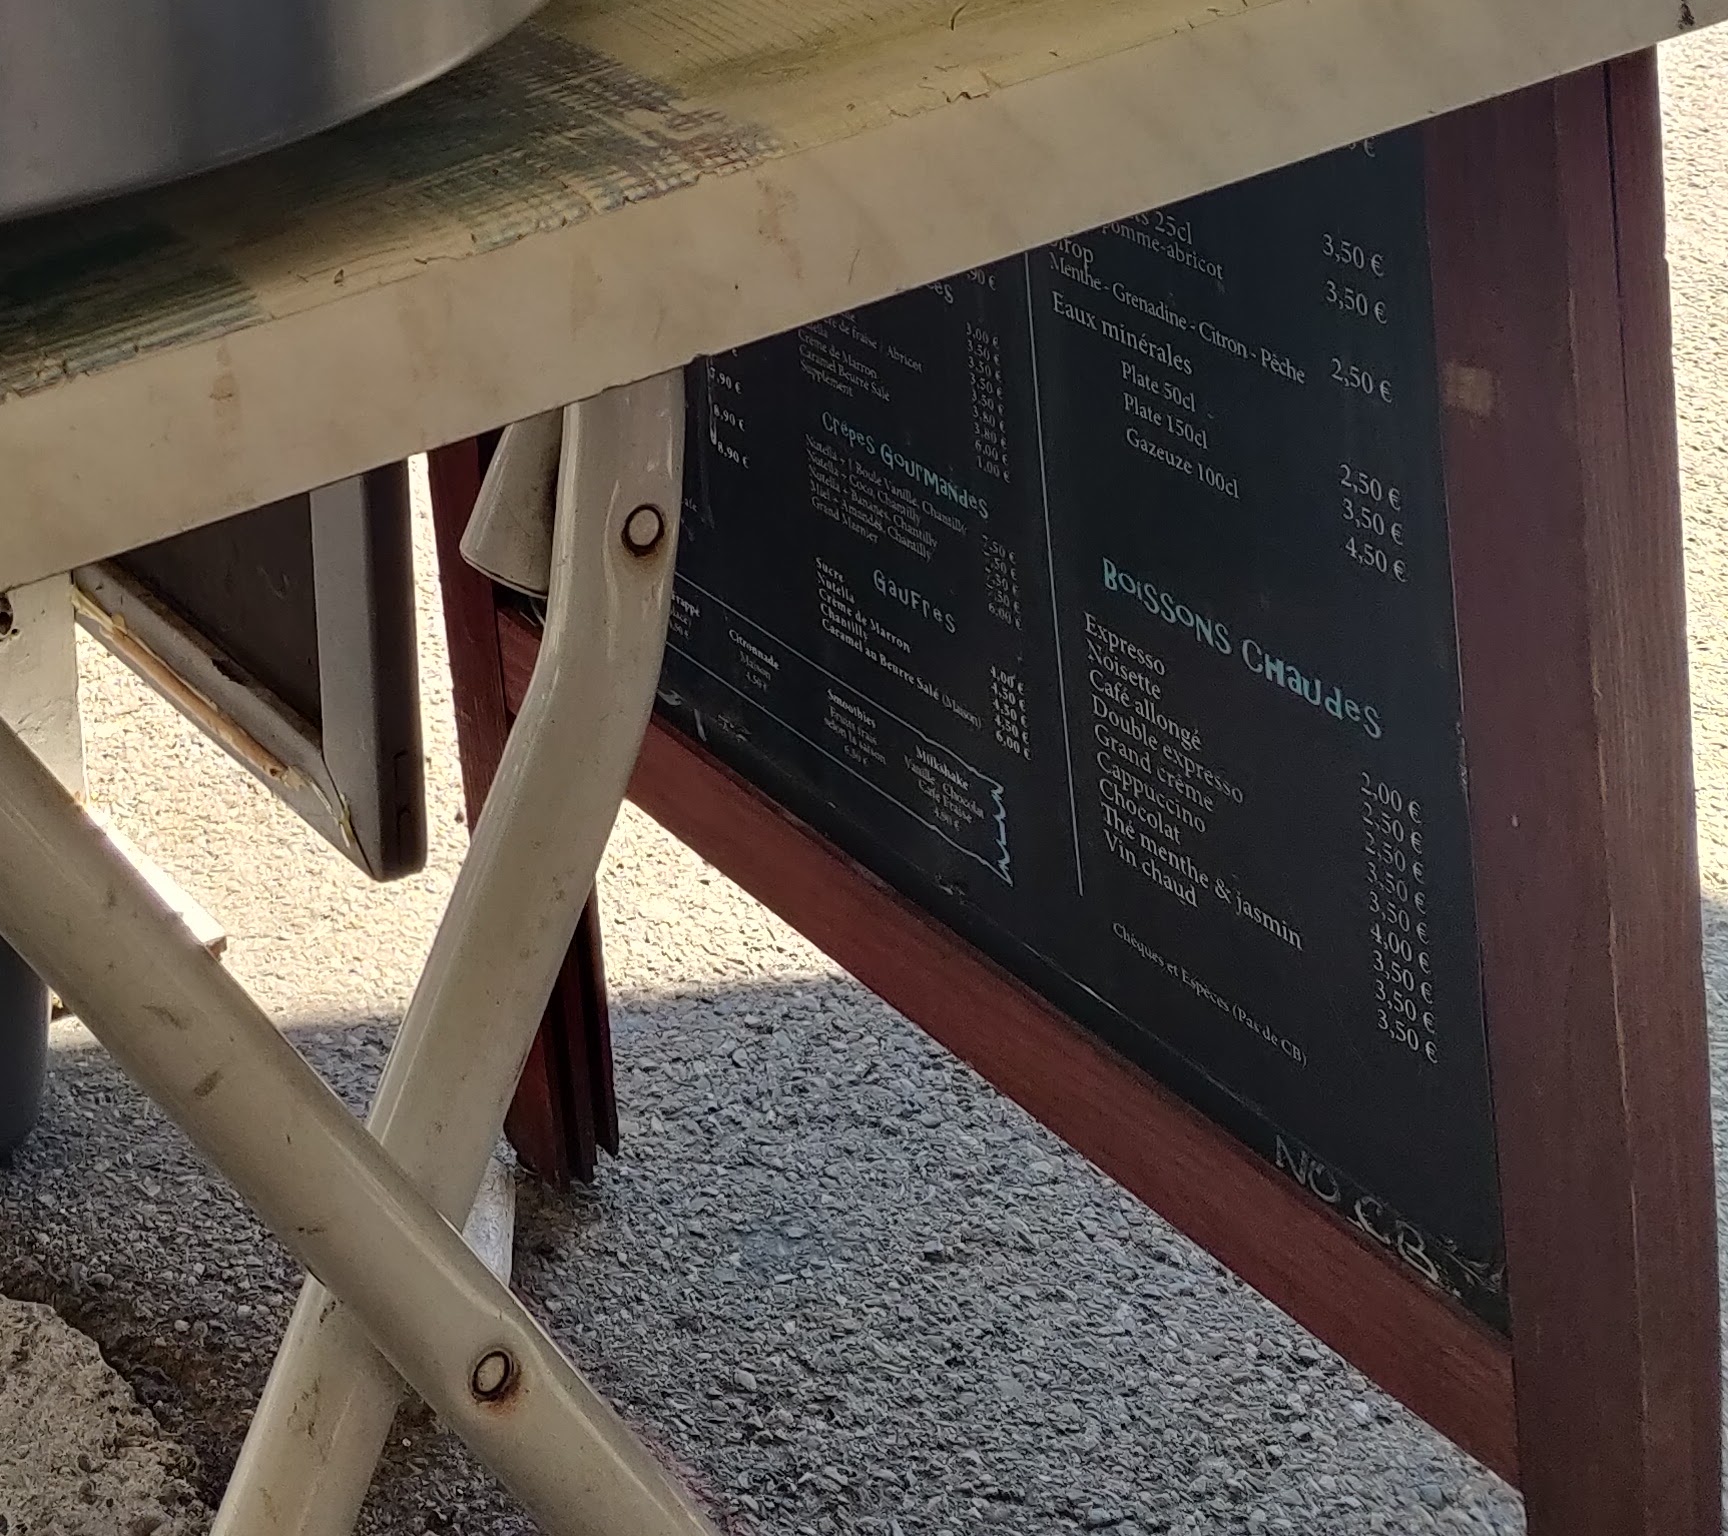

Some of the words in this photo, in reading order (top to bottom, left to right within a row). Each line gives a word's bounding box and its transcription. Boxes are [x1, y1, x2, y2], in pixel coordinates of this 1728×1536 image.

[1155, 210, 1193, 245] 25cl
[1322, 233, 1366, 270] 3,50
[1371, 253, 1385, 277] €
[1049, 252, 1102, 292] Menthe
[1112, 282, 1188, 330] Grenadine
[1198, 320, 1248, 360] Citron
[1260, 348, 1306, 385] Pêche
[1052, 290, 1098, 331] Eaux
[1101, 318, 1193, 376] minérales
[1326, 280, 1369, 317] 3,50
[1374, 300, 1388, 325] €
[1121, 360, 1160, 394] Plate
[1163, 381, 1196, 413] 50cl
[1123, 392, 1162, 426] Plate
[1167, 415, 1208, 450] 150cl
[1126, 427, 1193, 476] Gazeuze
[1197, 462, 1240, 500] 100cl
[880, 653, 915, 685] Beurre
[1085, 612, 1165, 676] Expresso
[1086, 639, 1162, 700] Noisette
[1089, 668, 1130, 704] Café
[1135, 699, 1202, 752] allongé
[1091, 693, 1158, 751] Double
[1162, 745, 1243, 805] expresso
[1094, 724, 1152, 775] Grand
[1157, 765, 1214, 813] crème
[1097, 751, 1207, 834] Cappuccino
[1099, 778, 1182, 845] Chocolat
[1101, 800, 1135, 840] Thé
[1139, 830, 1209, 889] menthe
[1214, 877, 1231, 904] &
[1235, 892, 1305, 952] jasmin
[1103, 828, 1138, 869] Vin
[1141, 860, 1200, 910] chaud
[1280, 1039, 1307, 1069] CB)
